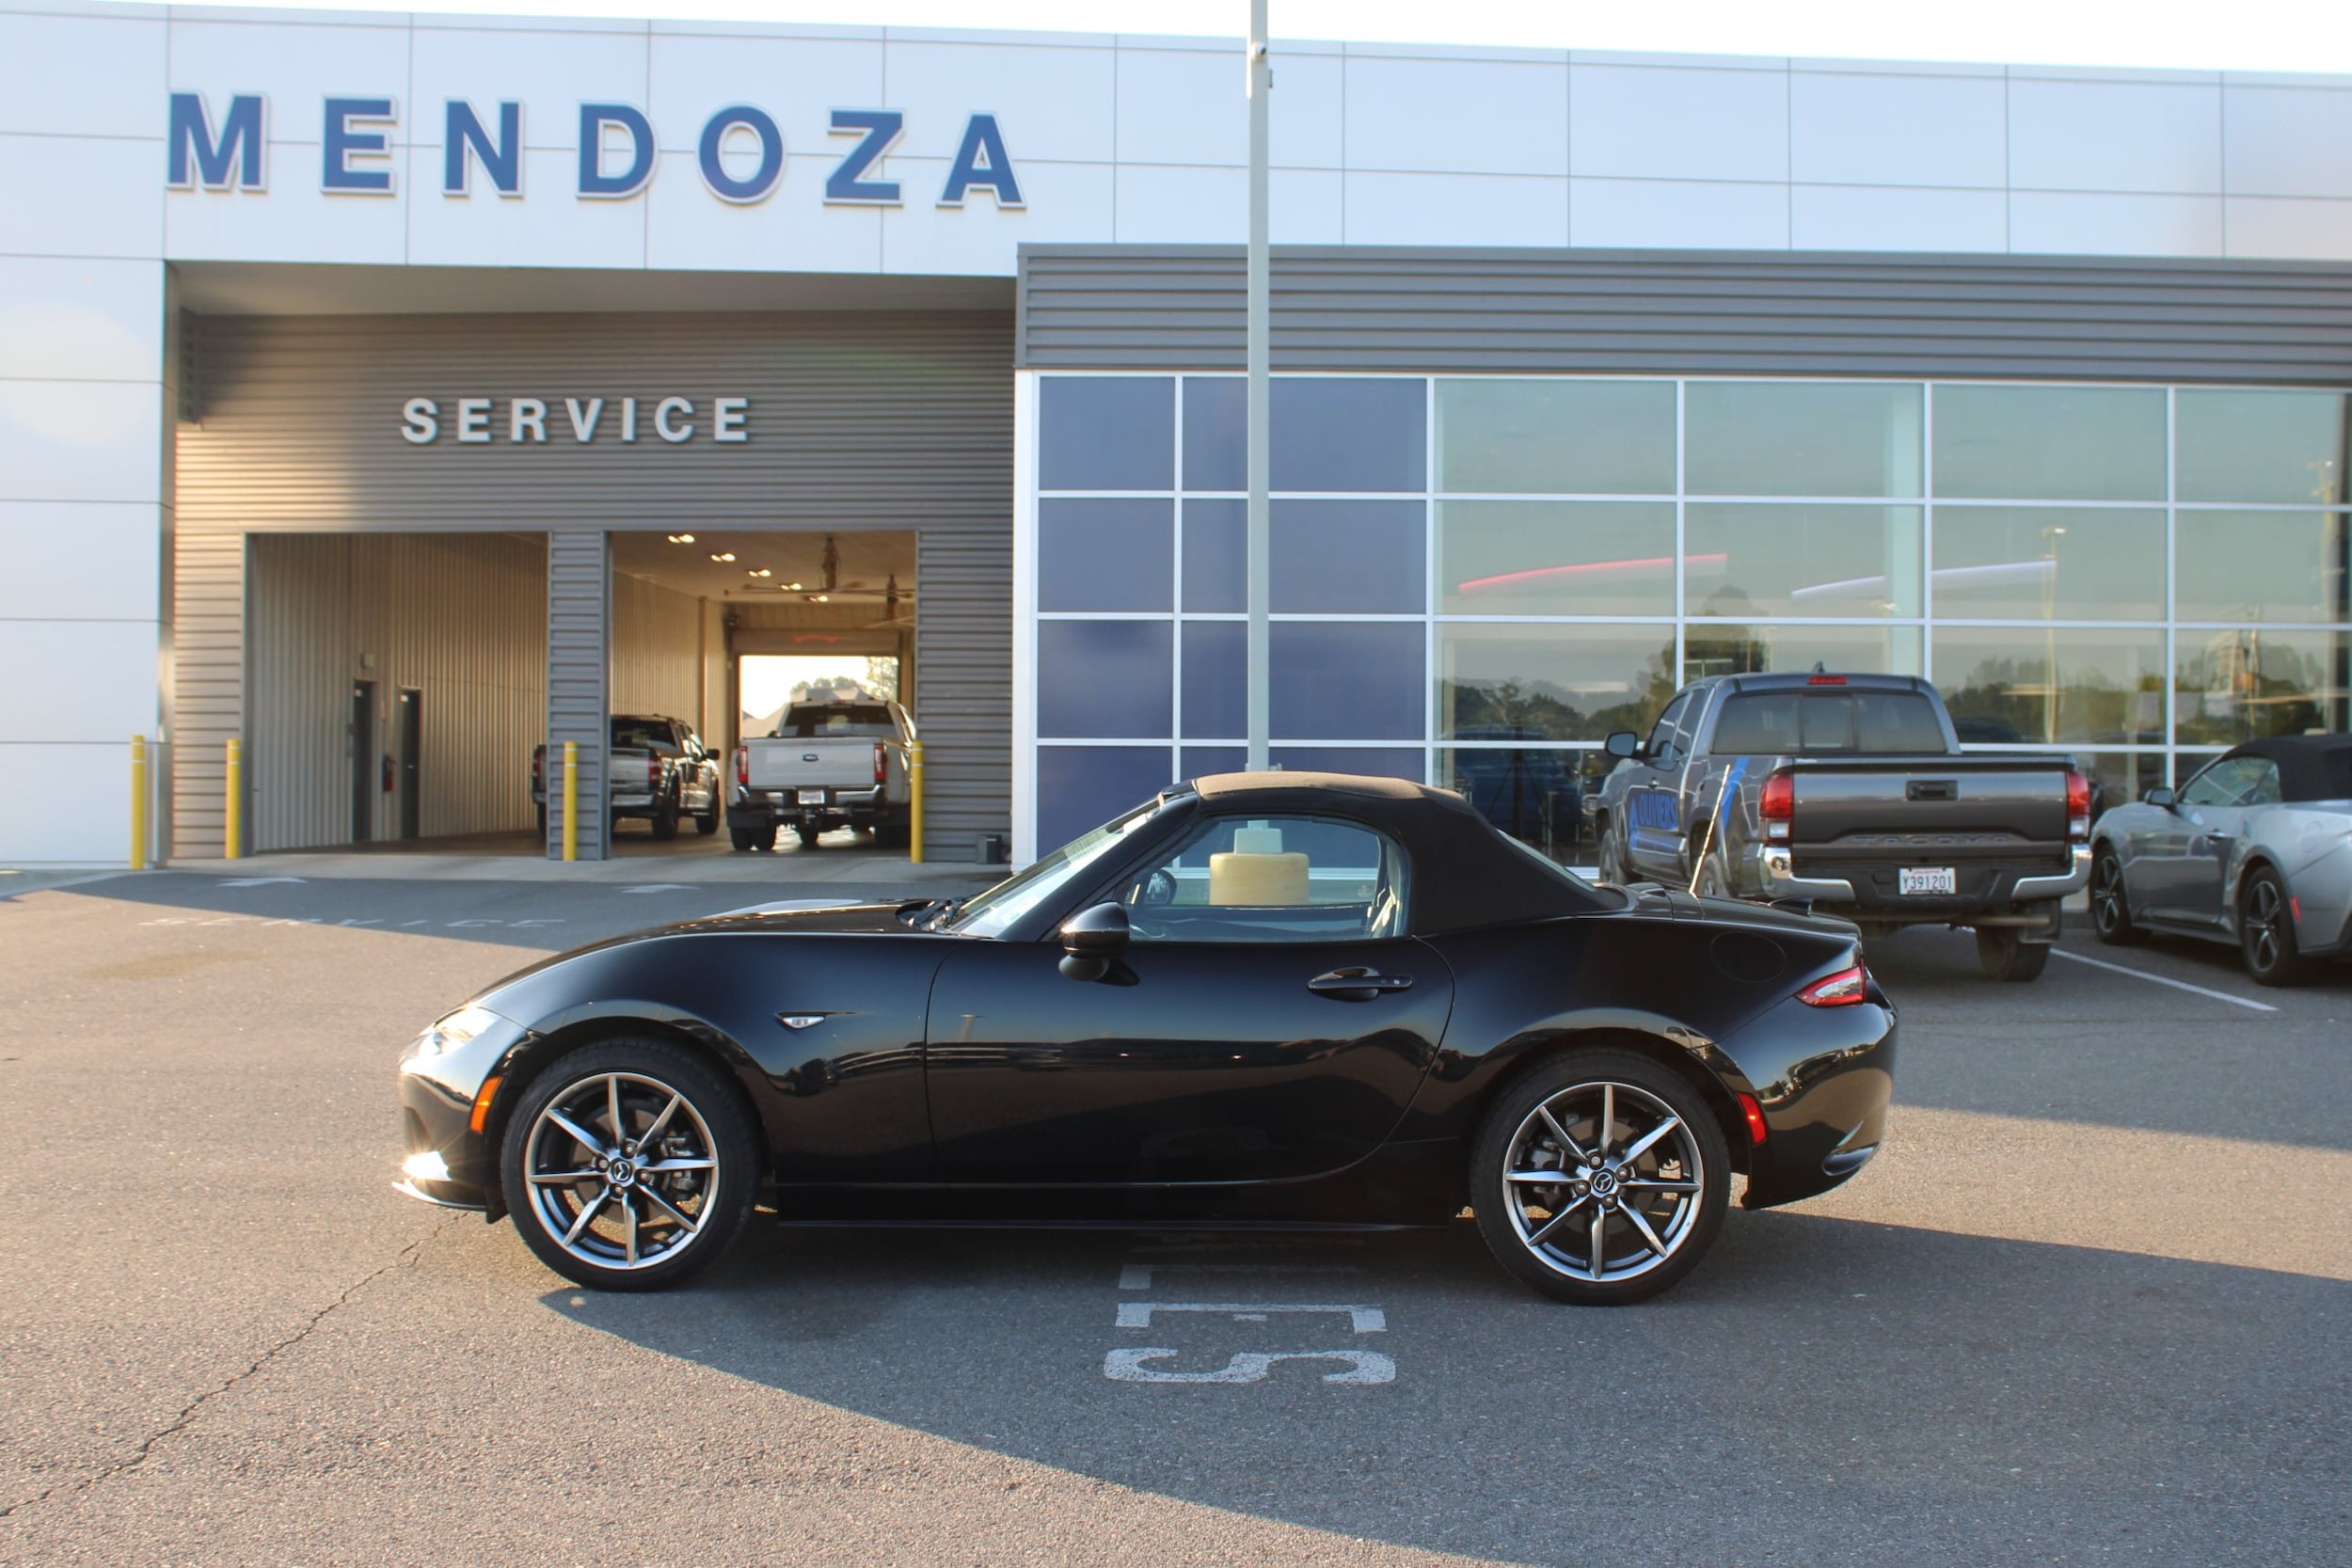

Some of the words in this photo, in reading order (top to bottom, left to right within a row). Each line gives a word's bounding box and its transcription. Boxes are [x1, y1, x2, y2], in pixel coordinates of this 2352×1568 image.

[167, 92, 1026, 208] MENDOZA
[401, 396, 749, 444] SERVICE
[1902, 876, 1952, 890] Y391201
